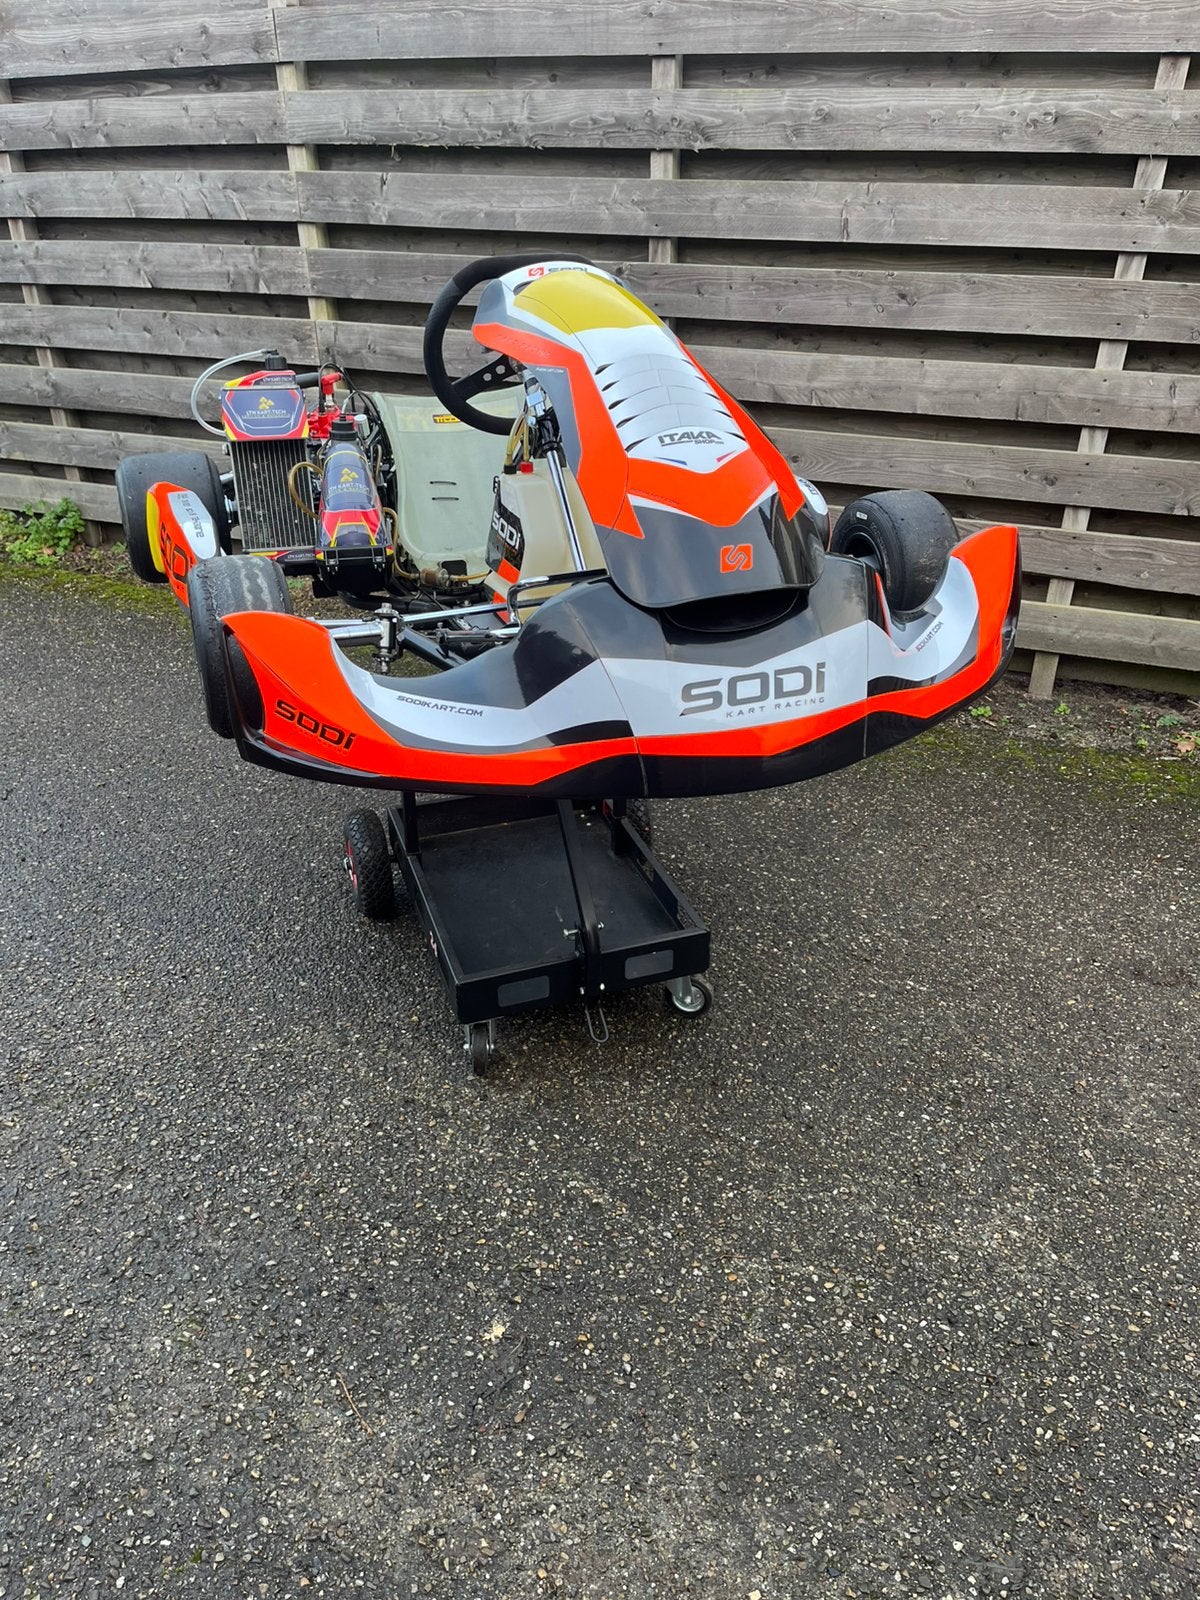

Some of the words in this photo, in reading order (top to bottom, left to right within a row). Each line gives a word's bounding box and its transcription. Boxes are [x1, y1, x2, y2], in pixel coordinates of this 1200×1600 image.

[658, 431, 722, 444] ITAKA
[396, 695, 484, 717] SODIKART.COM
[726, 705, 766, 718] KART
[774, 697, 825, 710] RACING
